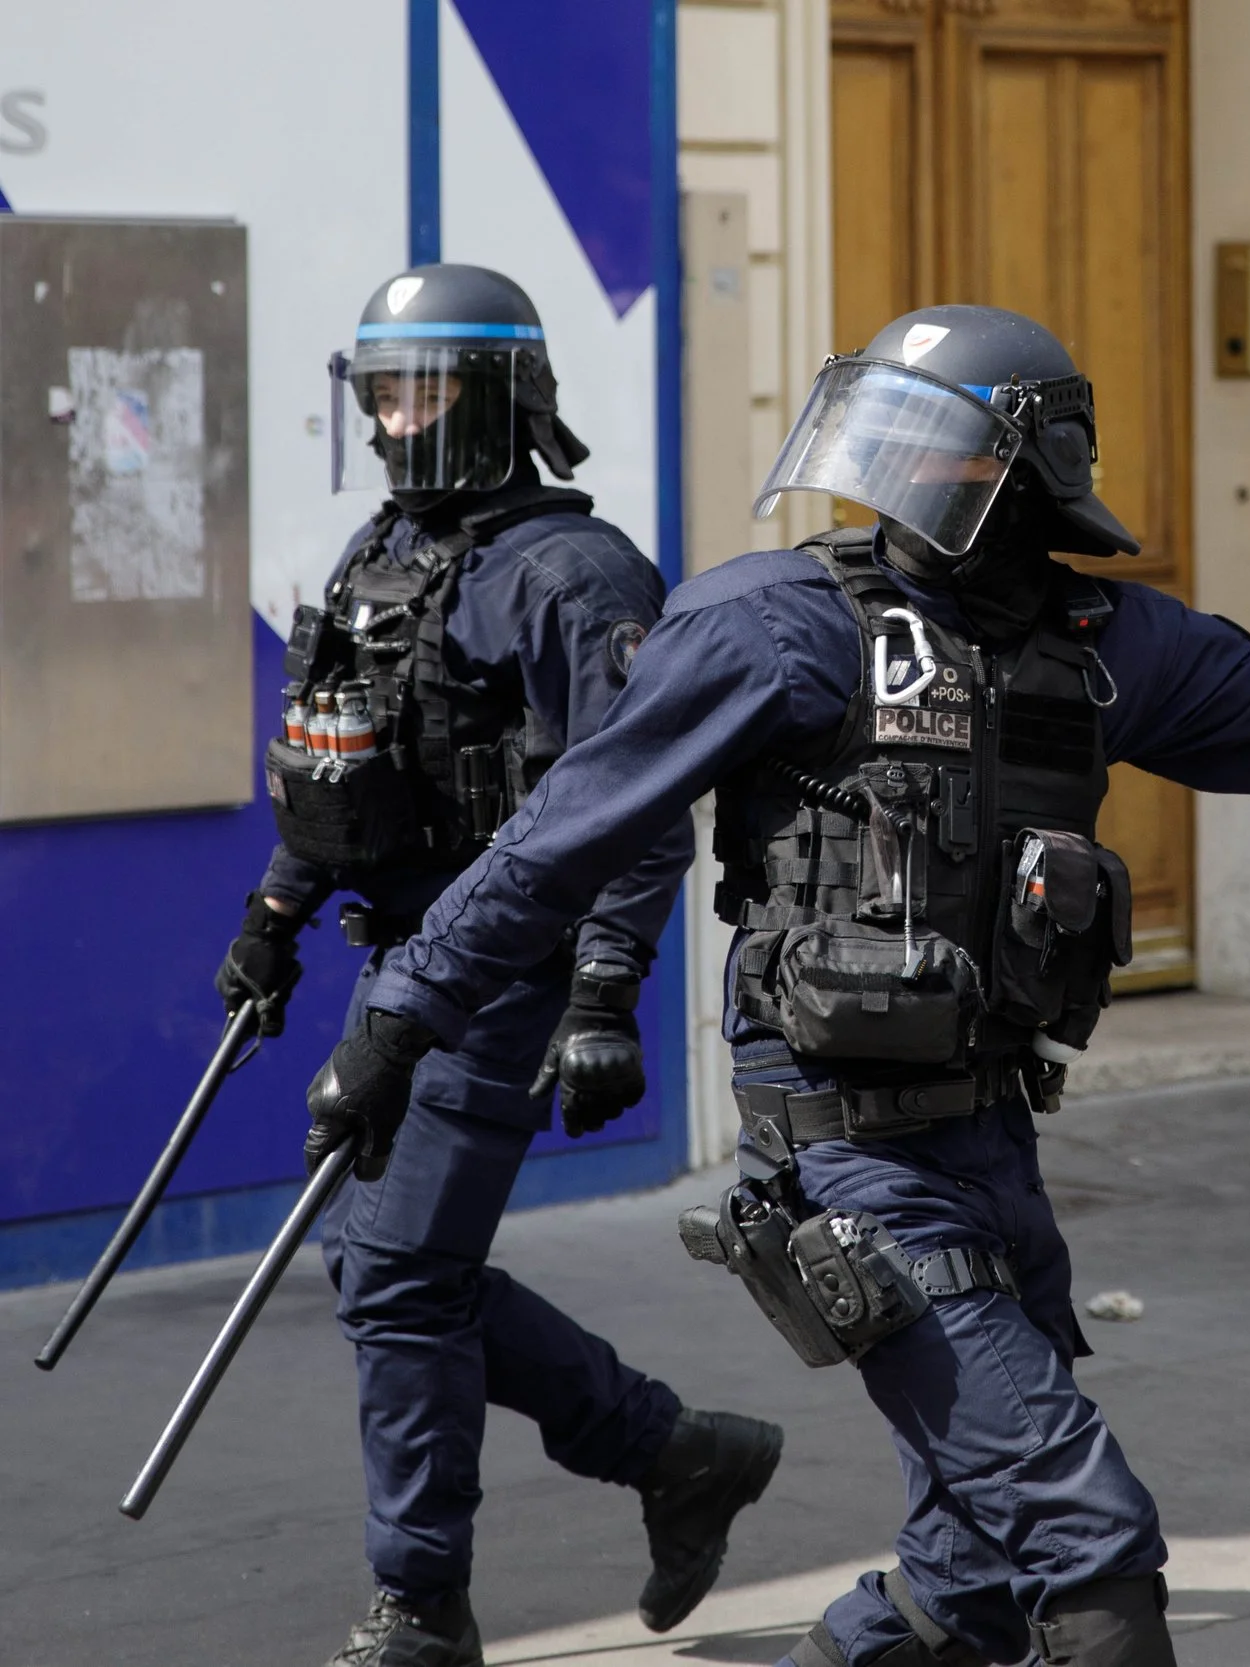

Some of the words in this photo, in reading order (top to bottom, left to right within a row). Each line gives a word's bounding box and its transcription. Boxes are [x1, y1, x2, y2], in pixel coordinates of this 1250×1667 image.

[879, 709, 969, 740] POLICE
[878, 734, 918, 742] COMPAGNIE
[920, 736, 968, 748] D'INTERVENTION
